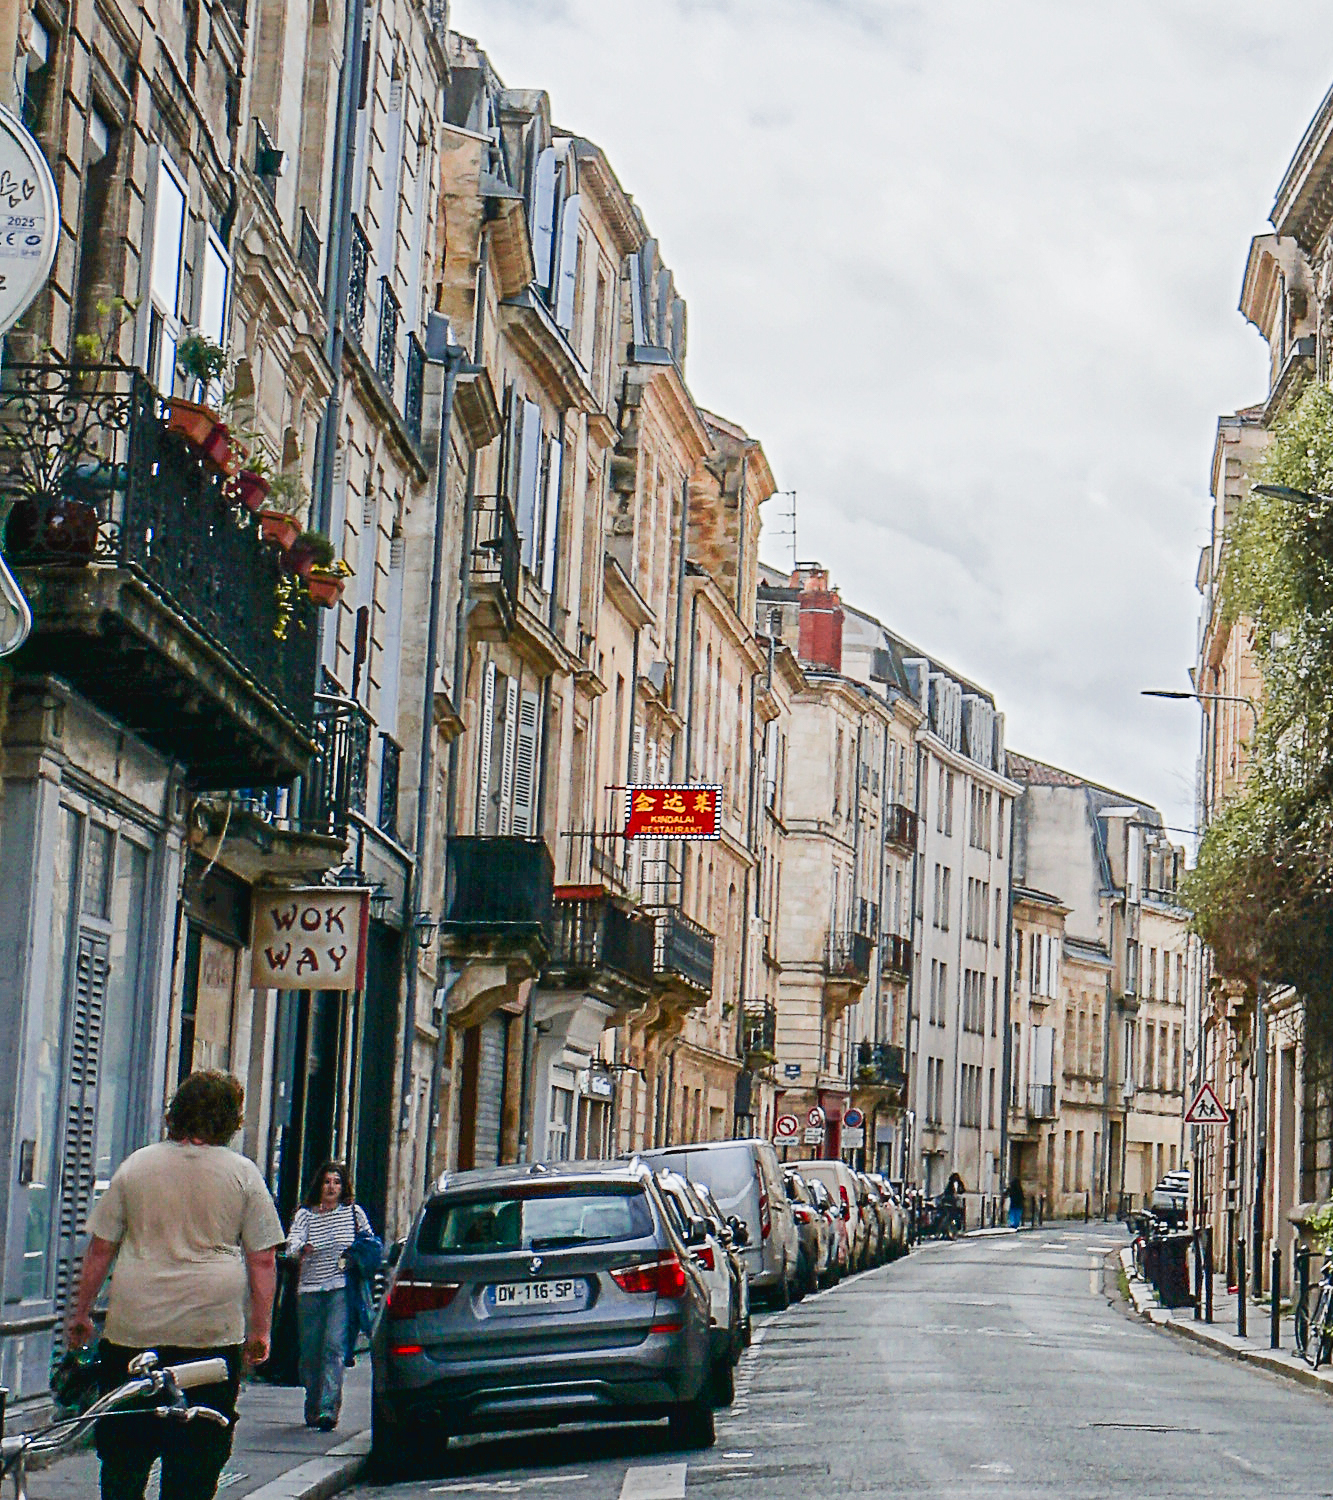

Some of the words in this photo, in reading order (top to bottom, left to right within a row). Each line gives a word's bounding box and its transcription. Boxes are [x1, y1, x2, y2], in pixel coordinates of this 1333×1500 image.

[7, 216, 35, 227] 2025
[641, 825, 703, 834] RESTAURANT
[271, 903, 346, 934] WOK
[264, 942, 348, 976] WAY
[499, 1283, 572, 1302] DW-116-SP
